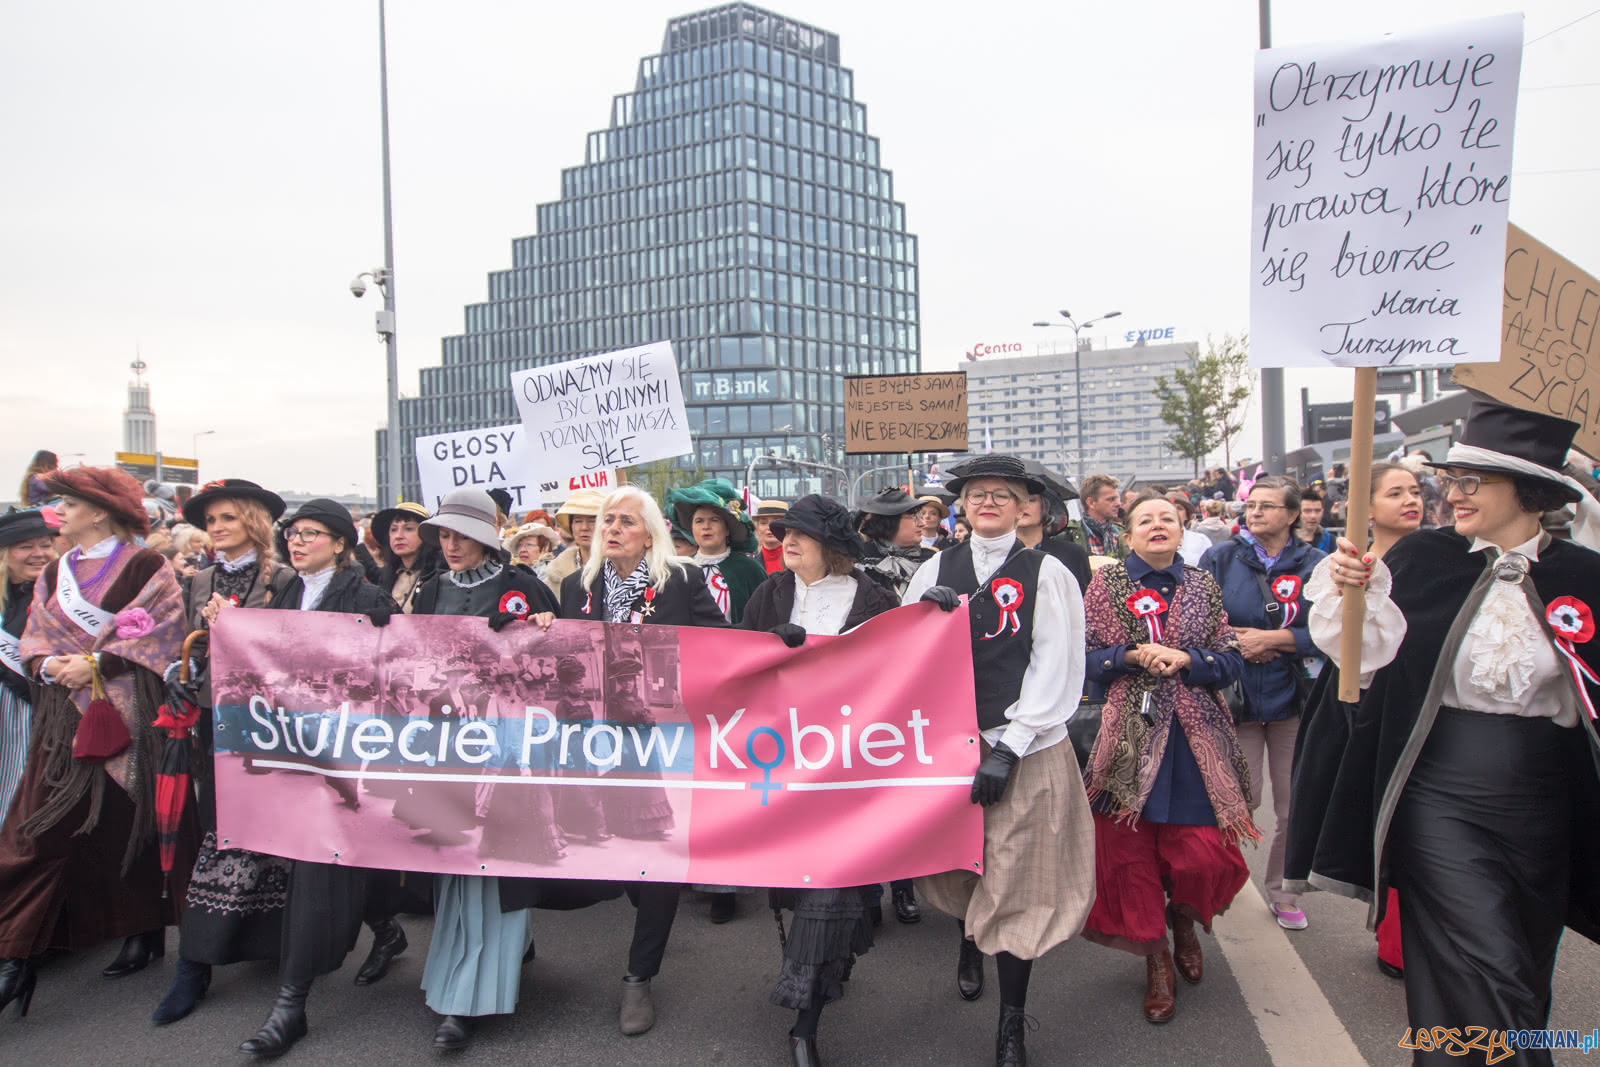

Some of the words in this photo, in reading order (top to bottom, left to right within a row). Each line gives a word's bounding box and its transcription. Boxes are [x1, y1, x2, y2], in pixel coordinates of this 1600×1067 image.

[1266, 139, 1315, 188] się
[1334, 112, 1441, 178] tylko
[1418, 162, 1510, 209] które
[1261, 248, 1308, 292] się
[1372, 289, 1462, 316] Maria
[974, 343, 1022, 357] Centra
[1125, 327, 1175, 342] EXIDE
[1319, 318, 1469, 364] Turzyma
[523, 360, 613, 404] ODWAŻMY
[622, 353, 653, 381] SIĘ
[695, 376, 770, 396] mBank
[849, 380, 874, 397] NIE
[595, 379, 669, 415] WOLNYMI
[920, 393, 962, 412] SAMA!
[540, 416, 620, 451] POZNAJMY
[627, 408, 679, 432] NASZĄ
[850, 419, 878, 441] NIE
[434, 431, 515, 461] GŁOSY
[582, 436, 639, 470] SIŁĘ
[452, 461, 506, 486] DLA
[249, 695, 496, 763] Stulecie
[521, 705, 685, 767] Praw
[706, 705, 933, 806] Kobiet
